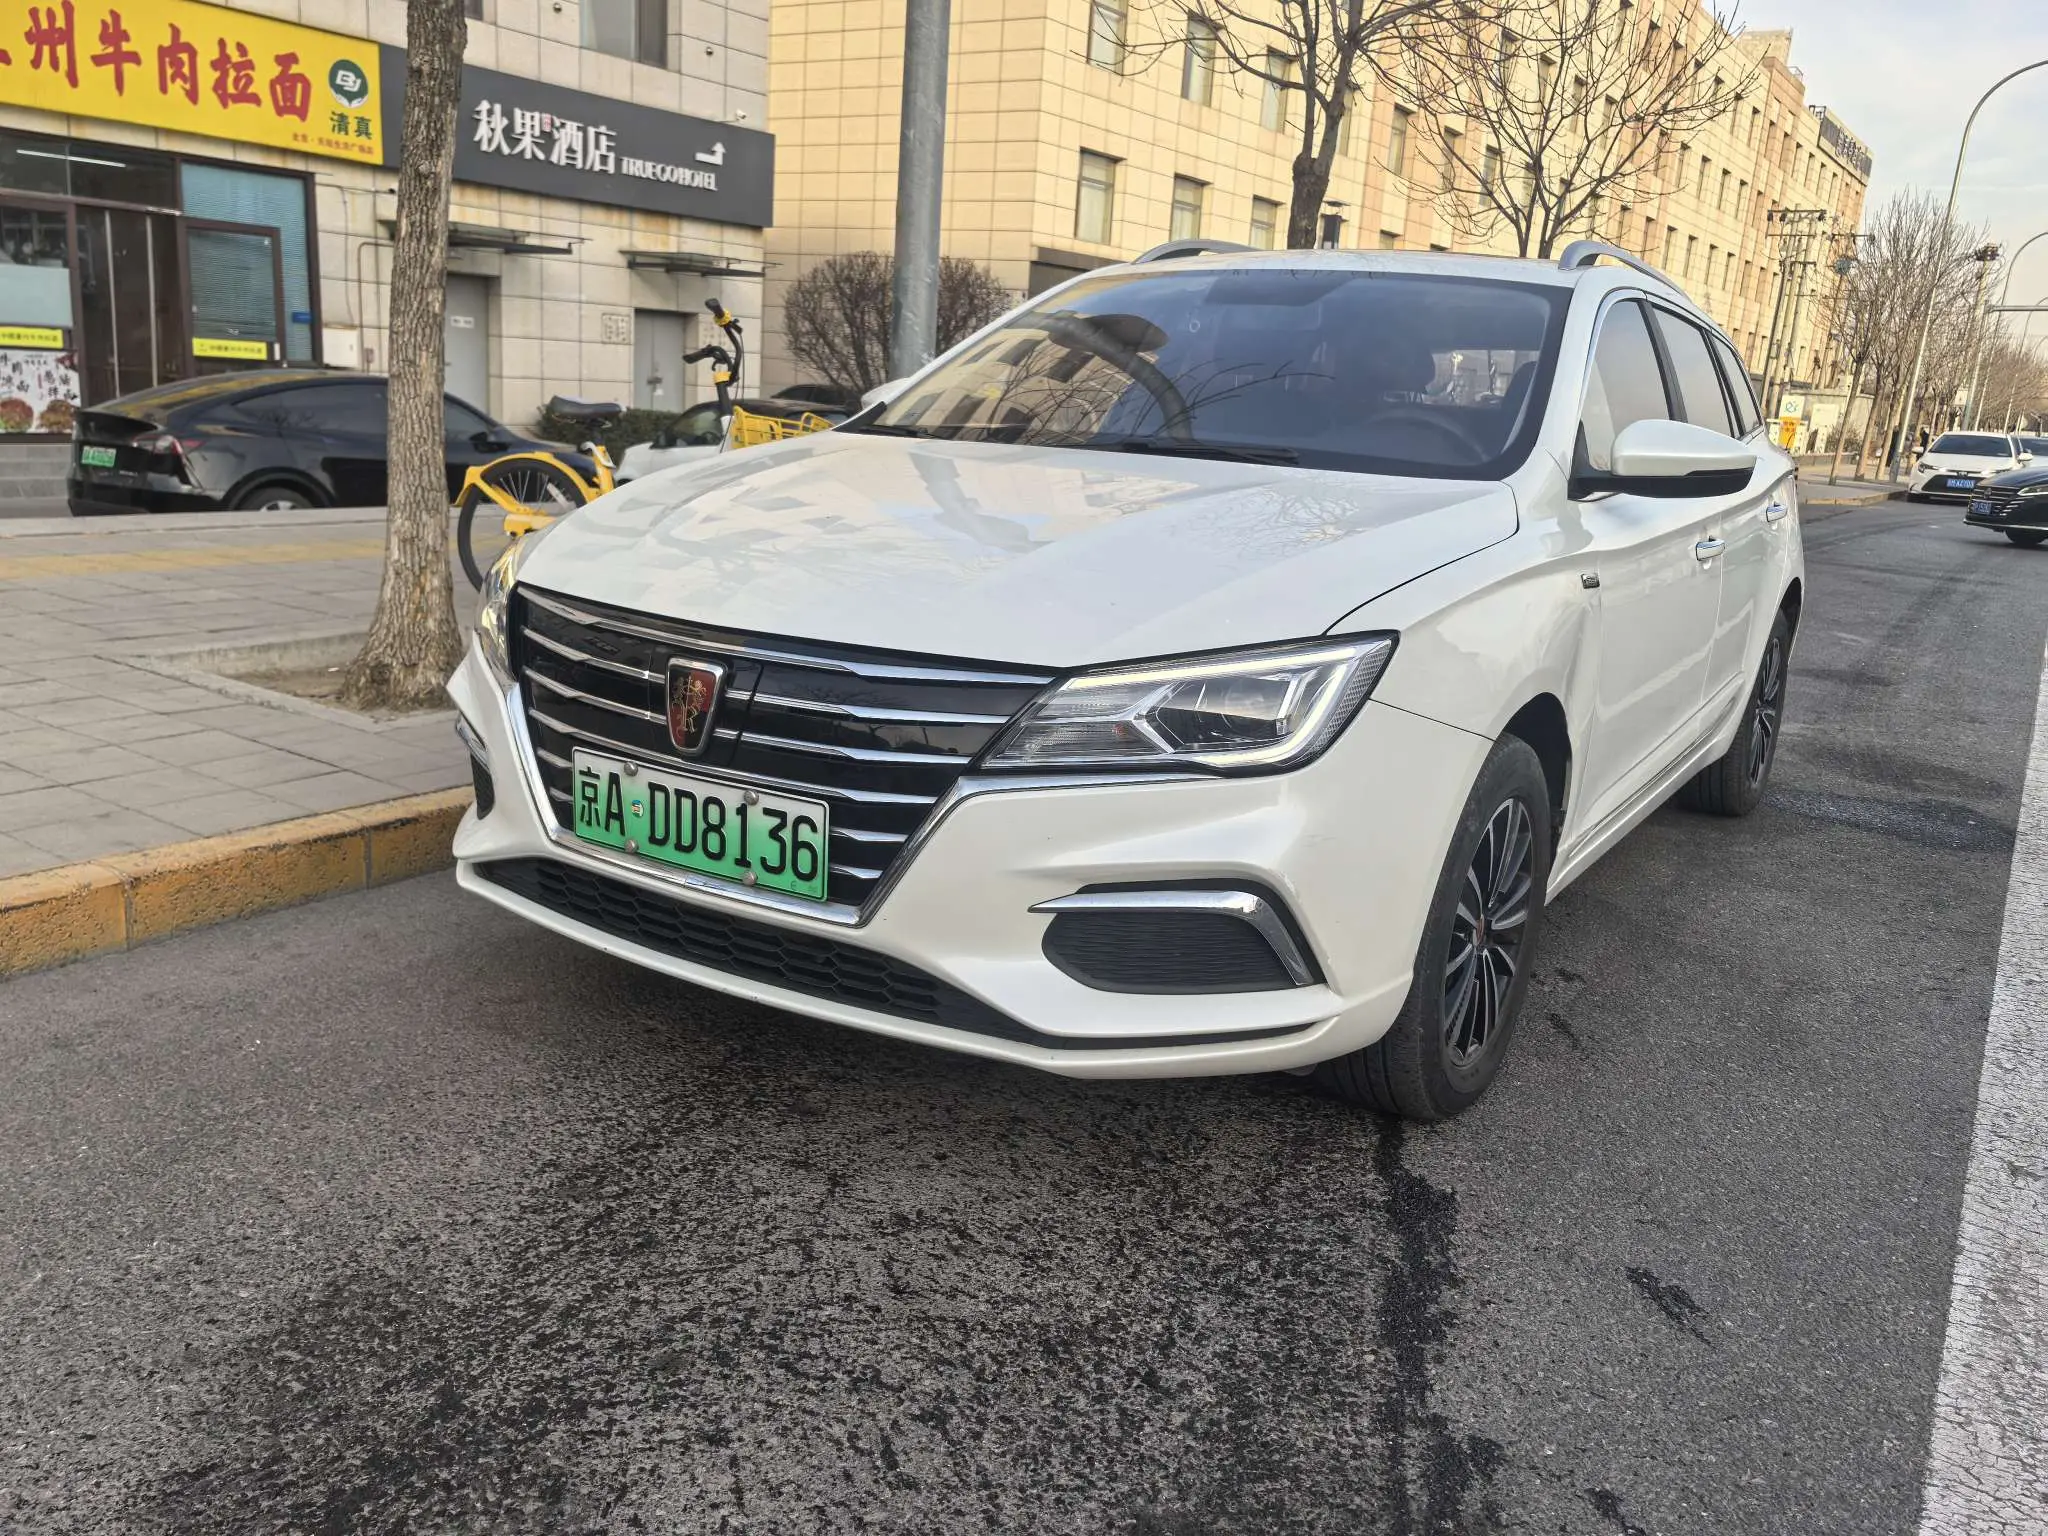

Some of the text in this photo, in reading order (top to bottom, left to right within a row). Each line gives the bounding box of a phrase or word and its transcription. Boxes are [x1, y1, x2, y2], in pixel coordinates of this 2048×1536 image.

[0, 0, 312, 122] 州牛肉拉面
[329, 111, 373, 140] 清真
[472, 99, 617, 174] 秋果酒店
